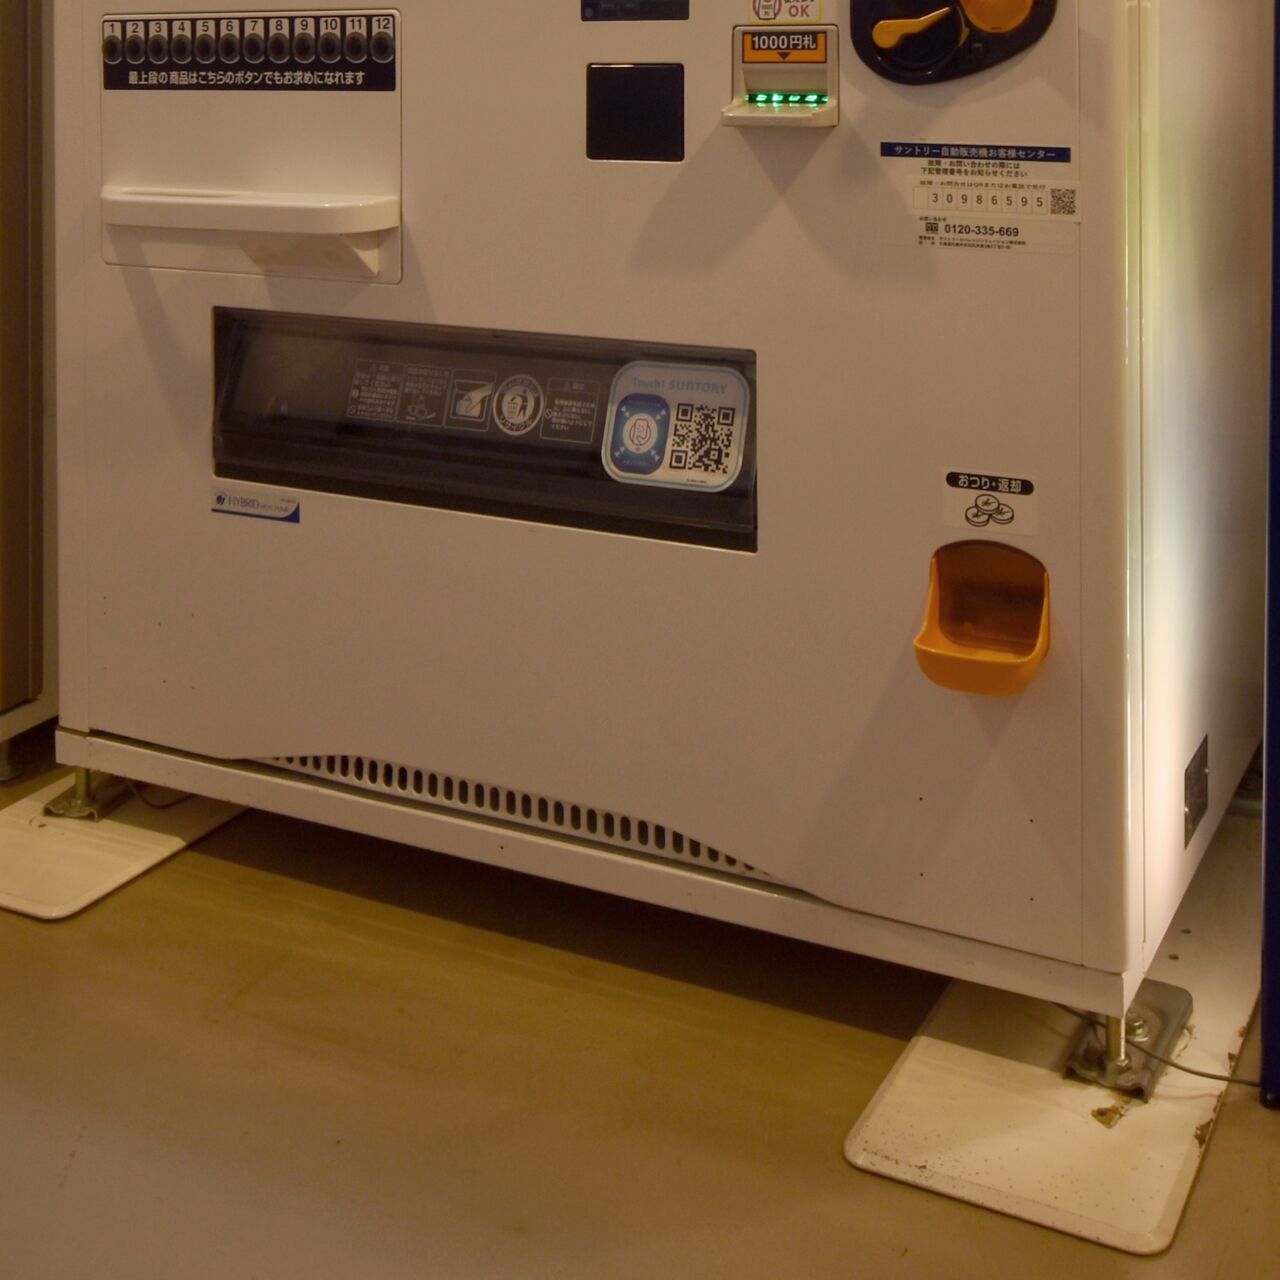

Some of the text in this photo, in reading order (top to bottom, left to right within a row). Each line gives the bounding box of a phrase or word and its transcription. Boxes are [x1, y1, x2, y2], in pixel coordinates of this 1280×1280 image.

[789, 5, 810, 17] OK
[110, 23, 116, 33] 1
[154, 22, 162, 32] 3
[202, 22, 209, 31] 5
[275, 20, 282, 30] 8
[323, 20, 338, 30] 10
[376, 18, 390, 29] 12
[753, 36, 816, 49] 1000円札
[128, 71, 366, 84] 最上段の商品はこちらのボタンでもお求めになれます
[894, 145, 1056, 158] サントリー自動販売機お客様センター
[944, 224, 1019, 237] 0120-335-669
[958, 475, 1022, 492] おつり・返却
